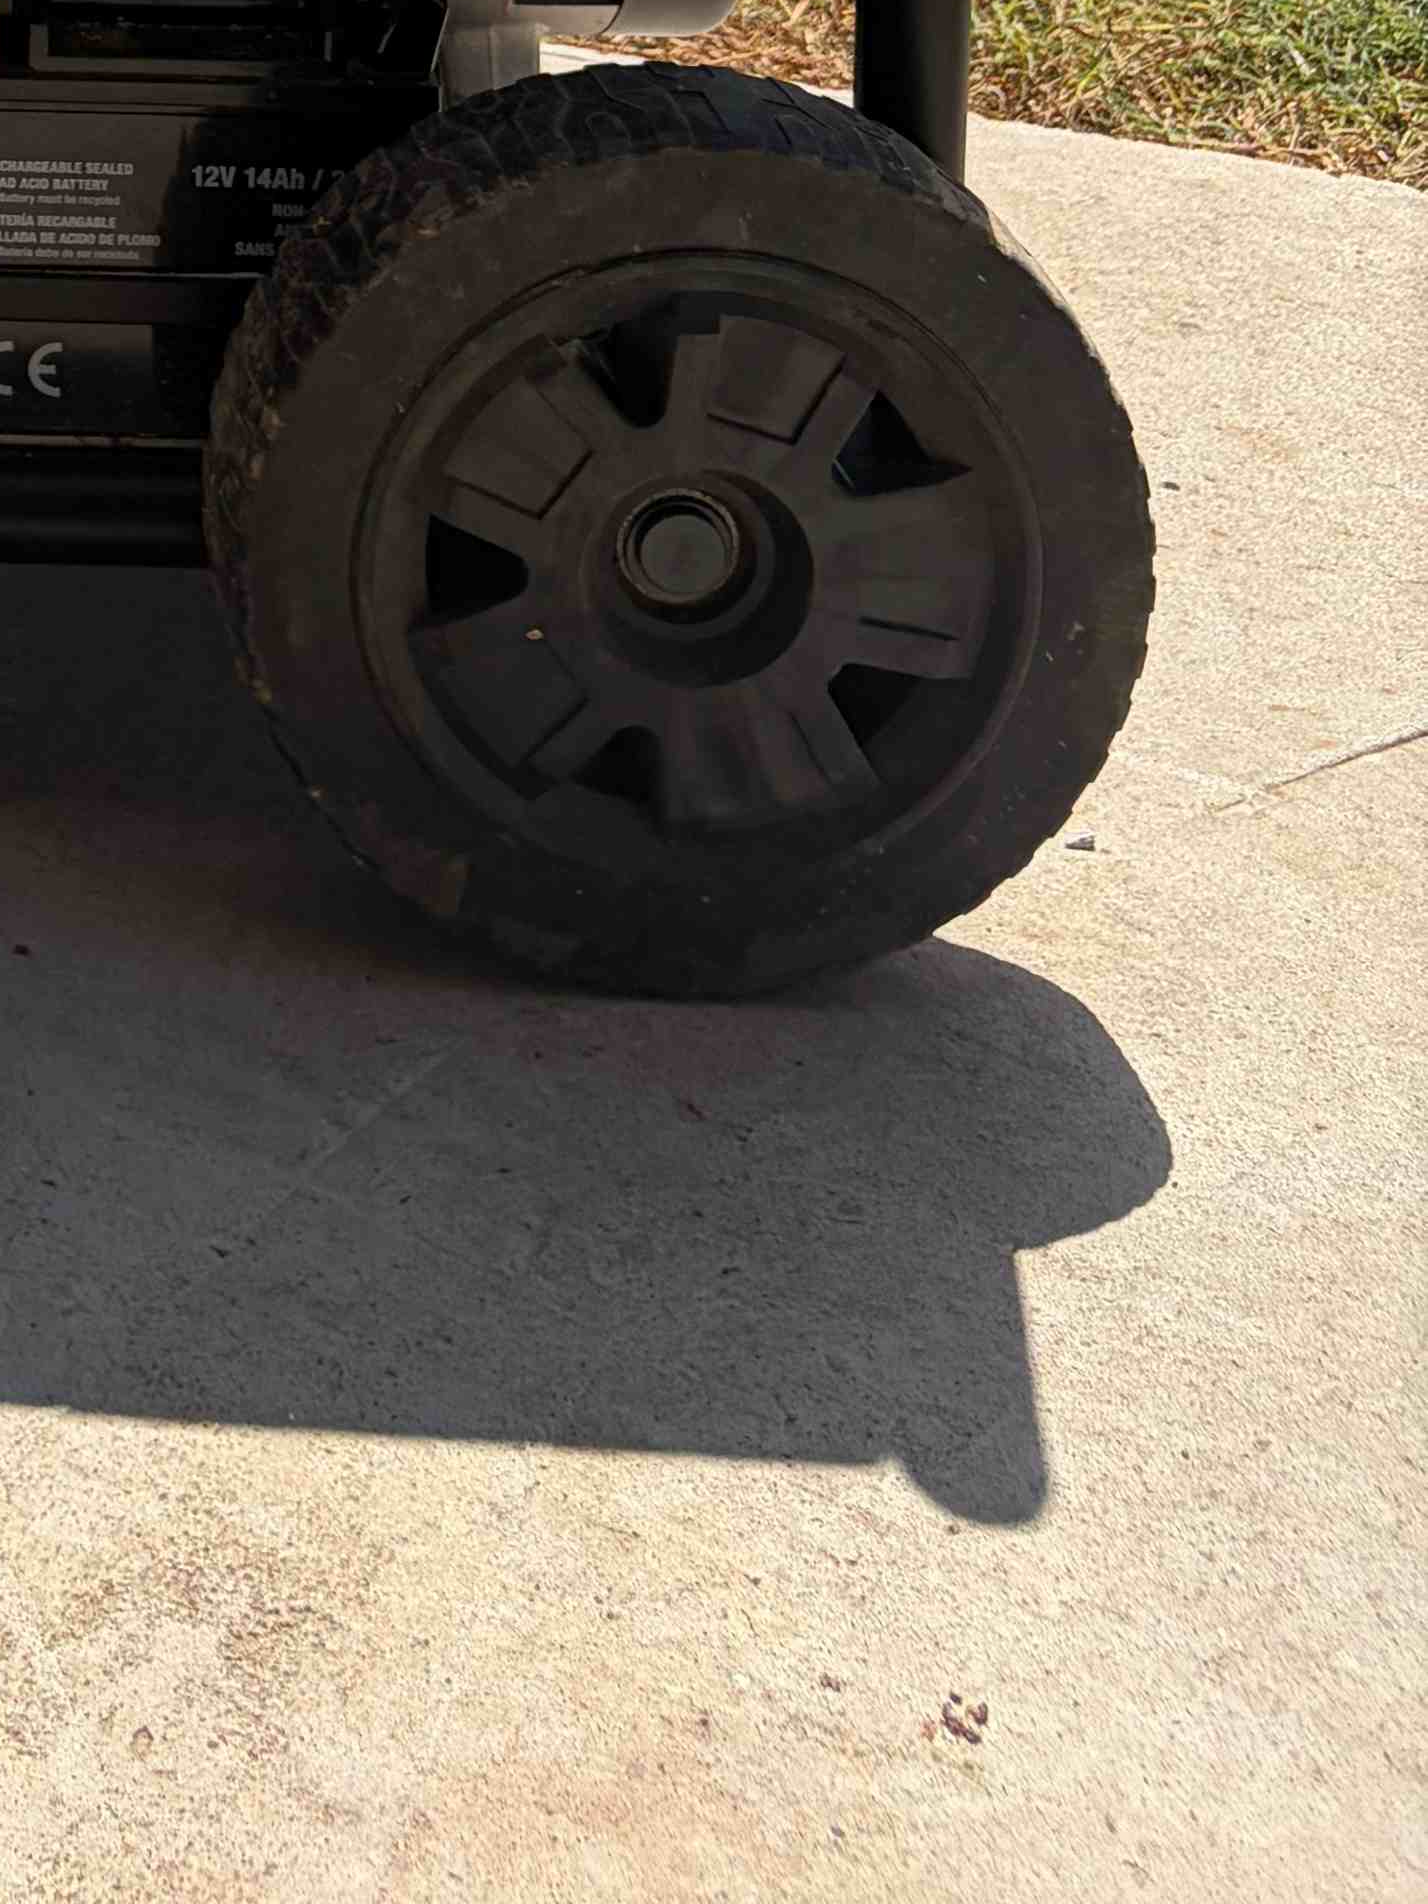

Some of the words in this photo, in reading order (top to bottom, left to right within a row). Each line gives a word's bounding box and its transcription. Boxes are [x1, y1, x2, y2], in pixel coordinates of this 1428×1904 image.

[85, 162, 134, 176] SEALED
[18, 177, 49, 190] ACID
[52, 178, 109, 191] BATTERY
[191, 164, 237, 188] 12V
[242, 166, 305, 190] 14Ah
[311, 168, 325, 191] /
[234, 241, 275, 256] SANS
